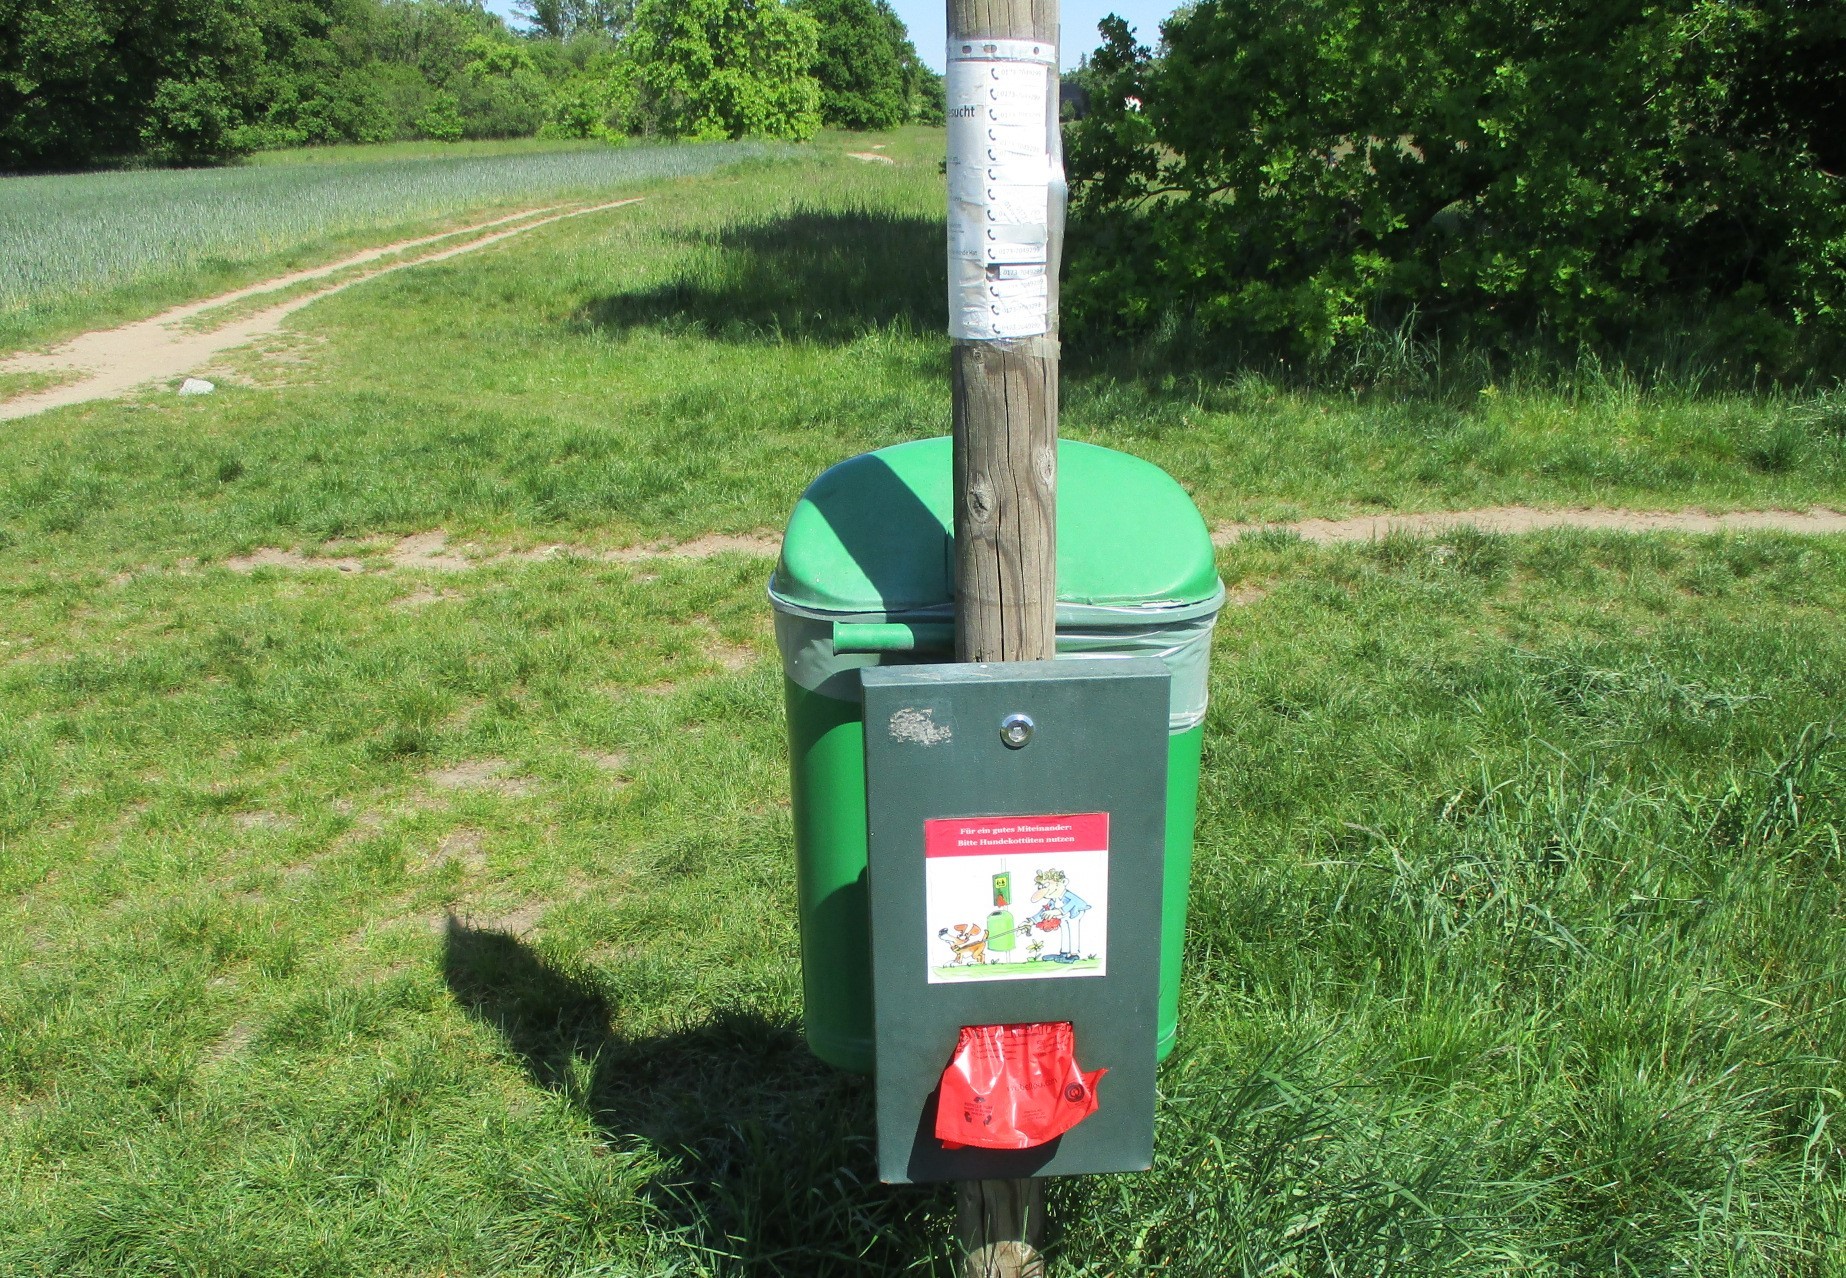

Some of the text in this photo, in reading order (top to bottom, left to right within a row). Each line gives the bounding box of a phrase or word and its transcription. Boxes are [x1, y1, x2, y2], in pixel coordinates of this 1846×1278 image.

[977, 827, 991, 835] ein
[992, 827, 1015, 835] gutes
[1017, 824, 1072, 832] Miteinander:
[957, 839, 978, 847] Bitte
[979, 837, 1044, 845] Hundekottüten
